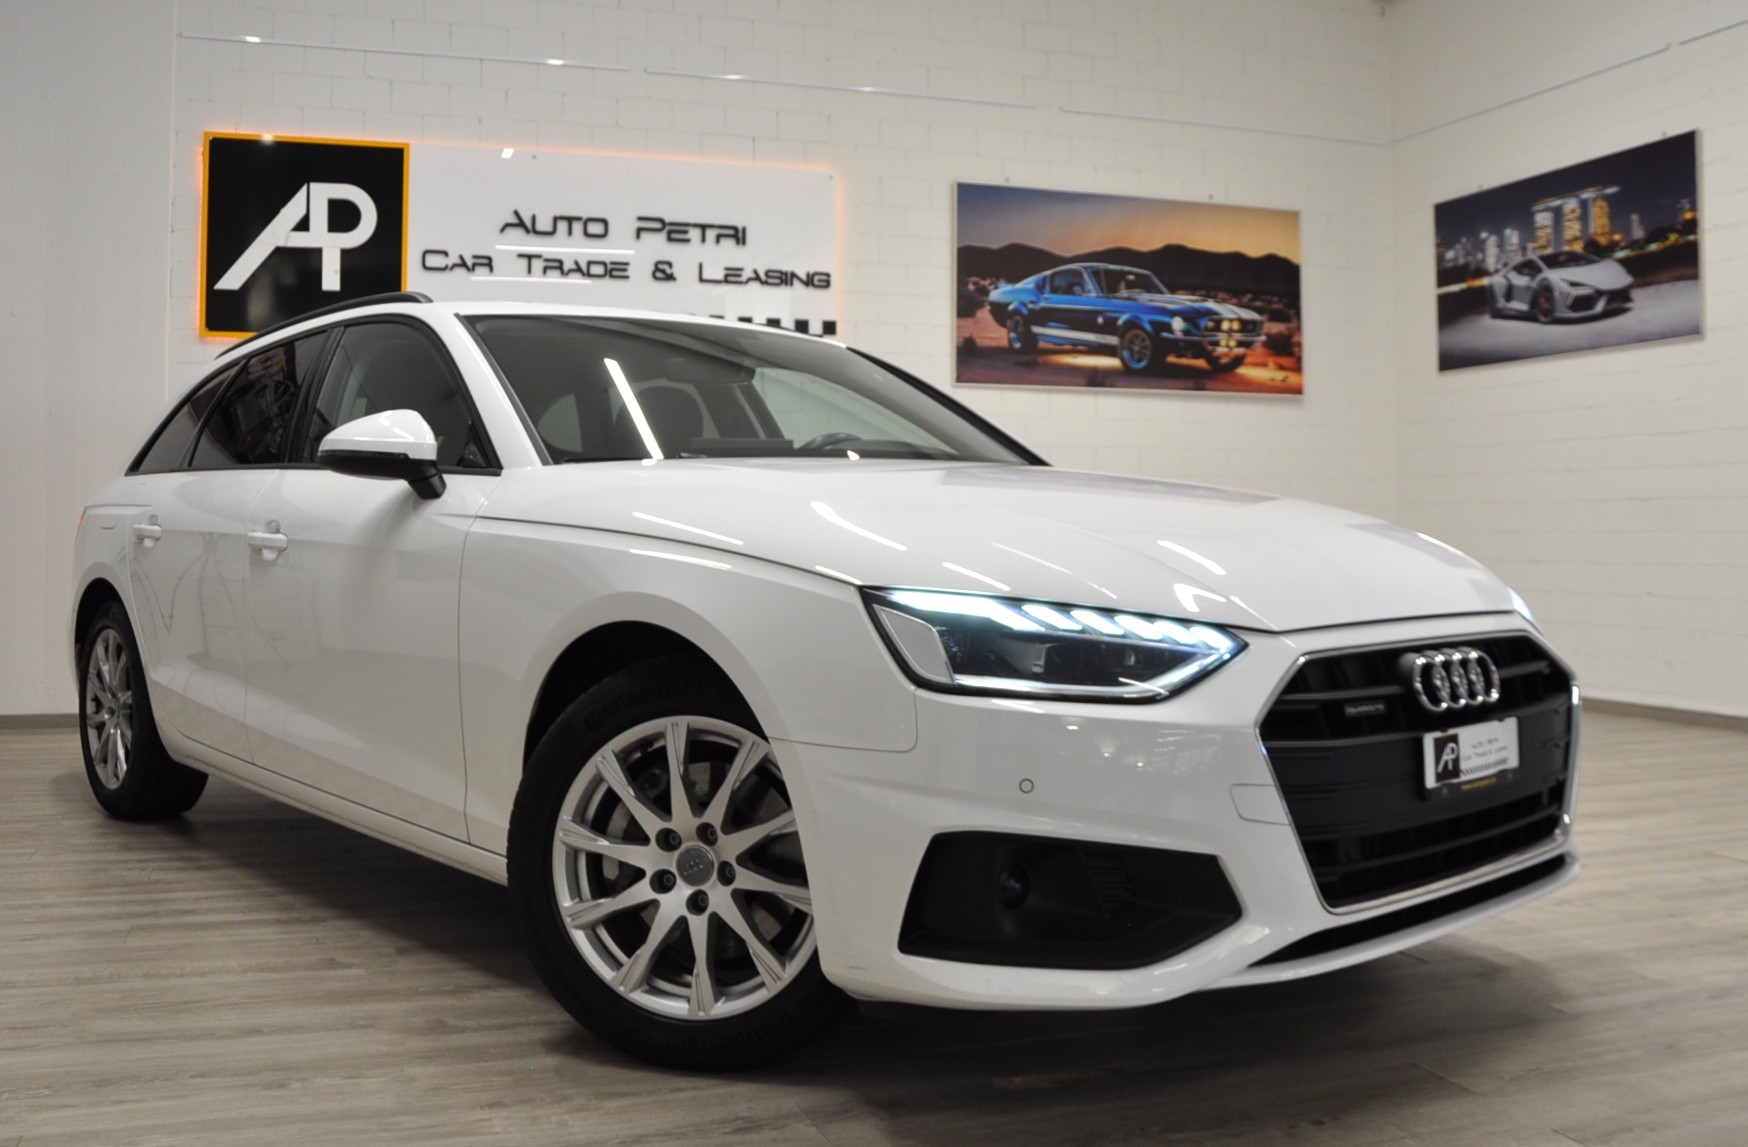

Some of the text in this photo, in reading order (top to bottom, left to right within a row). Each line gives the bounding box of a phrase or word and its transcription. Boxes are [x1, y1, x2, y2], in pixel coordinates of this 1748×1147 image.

[213, 181, 378, 292] AP
[500, 209, 747, 246] AUTO PETRI
[422, 249, 832, 290] CAR TRADE & LEASING
